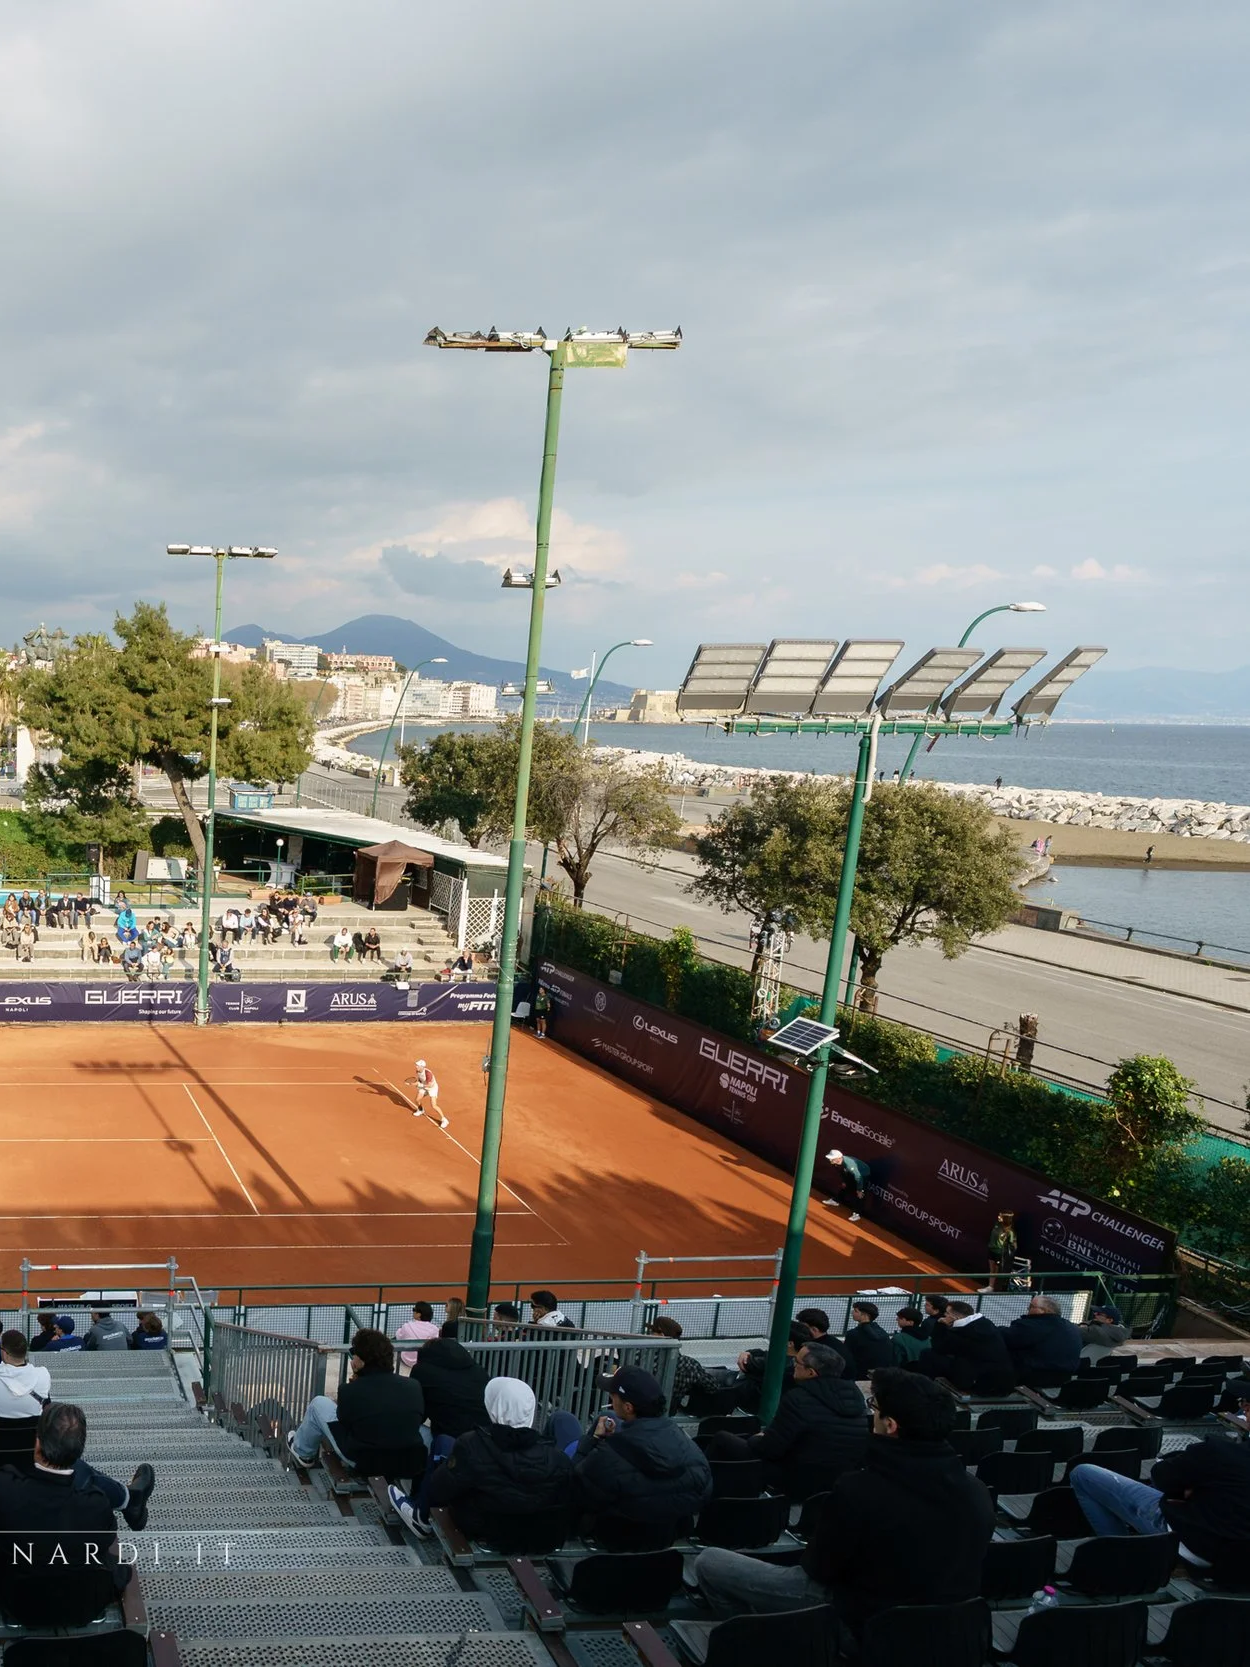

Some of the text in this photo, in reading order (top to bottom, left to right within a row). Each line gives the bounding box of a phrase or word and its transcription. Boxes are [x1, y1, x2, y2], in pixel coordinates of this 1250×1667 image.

[85, 990, 183, 1005] GUERRI
[330, 993, 367, 1005] ARUS
[644, 1022, 679, 1045] LEXUS
[699, 1037, 789, 1095] GUERRI
[729, 1086, 757, 1103] TENNIS CUP
[730, 1076, 758, 1097] NAPOLI
[831, 1110, 893, 1148] EnergiaSociale
[939, 1159, 979, 1188] ARUS
[867, 1181, 894, 1205] ASTER
[894, 1197, 929, 1222] GROUP
[928, 1215, 962, 1240] SPORT
[1036, 1188, 1166, 1252] ATP CHALLENGER
[1039, 1245, 1081, 1271] ACQUISTA
[1068, 1239, 1095, 1260] BNL
[1069, 1232, 1142, 1272] INTERNAZIONALI
